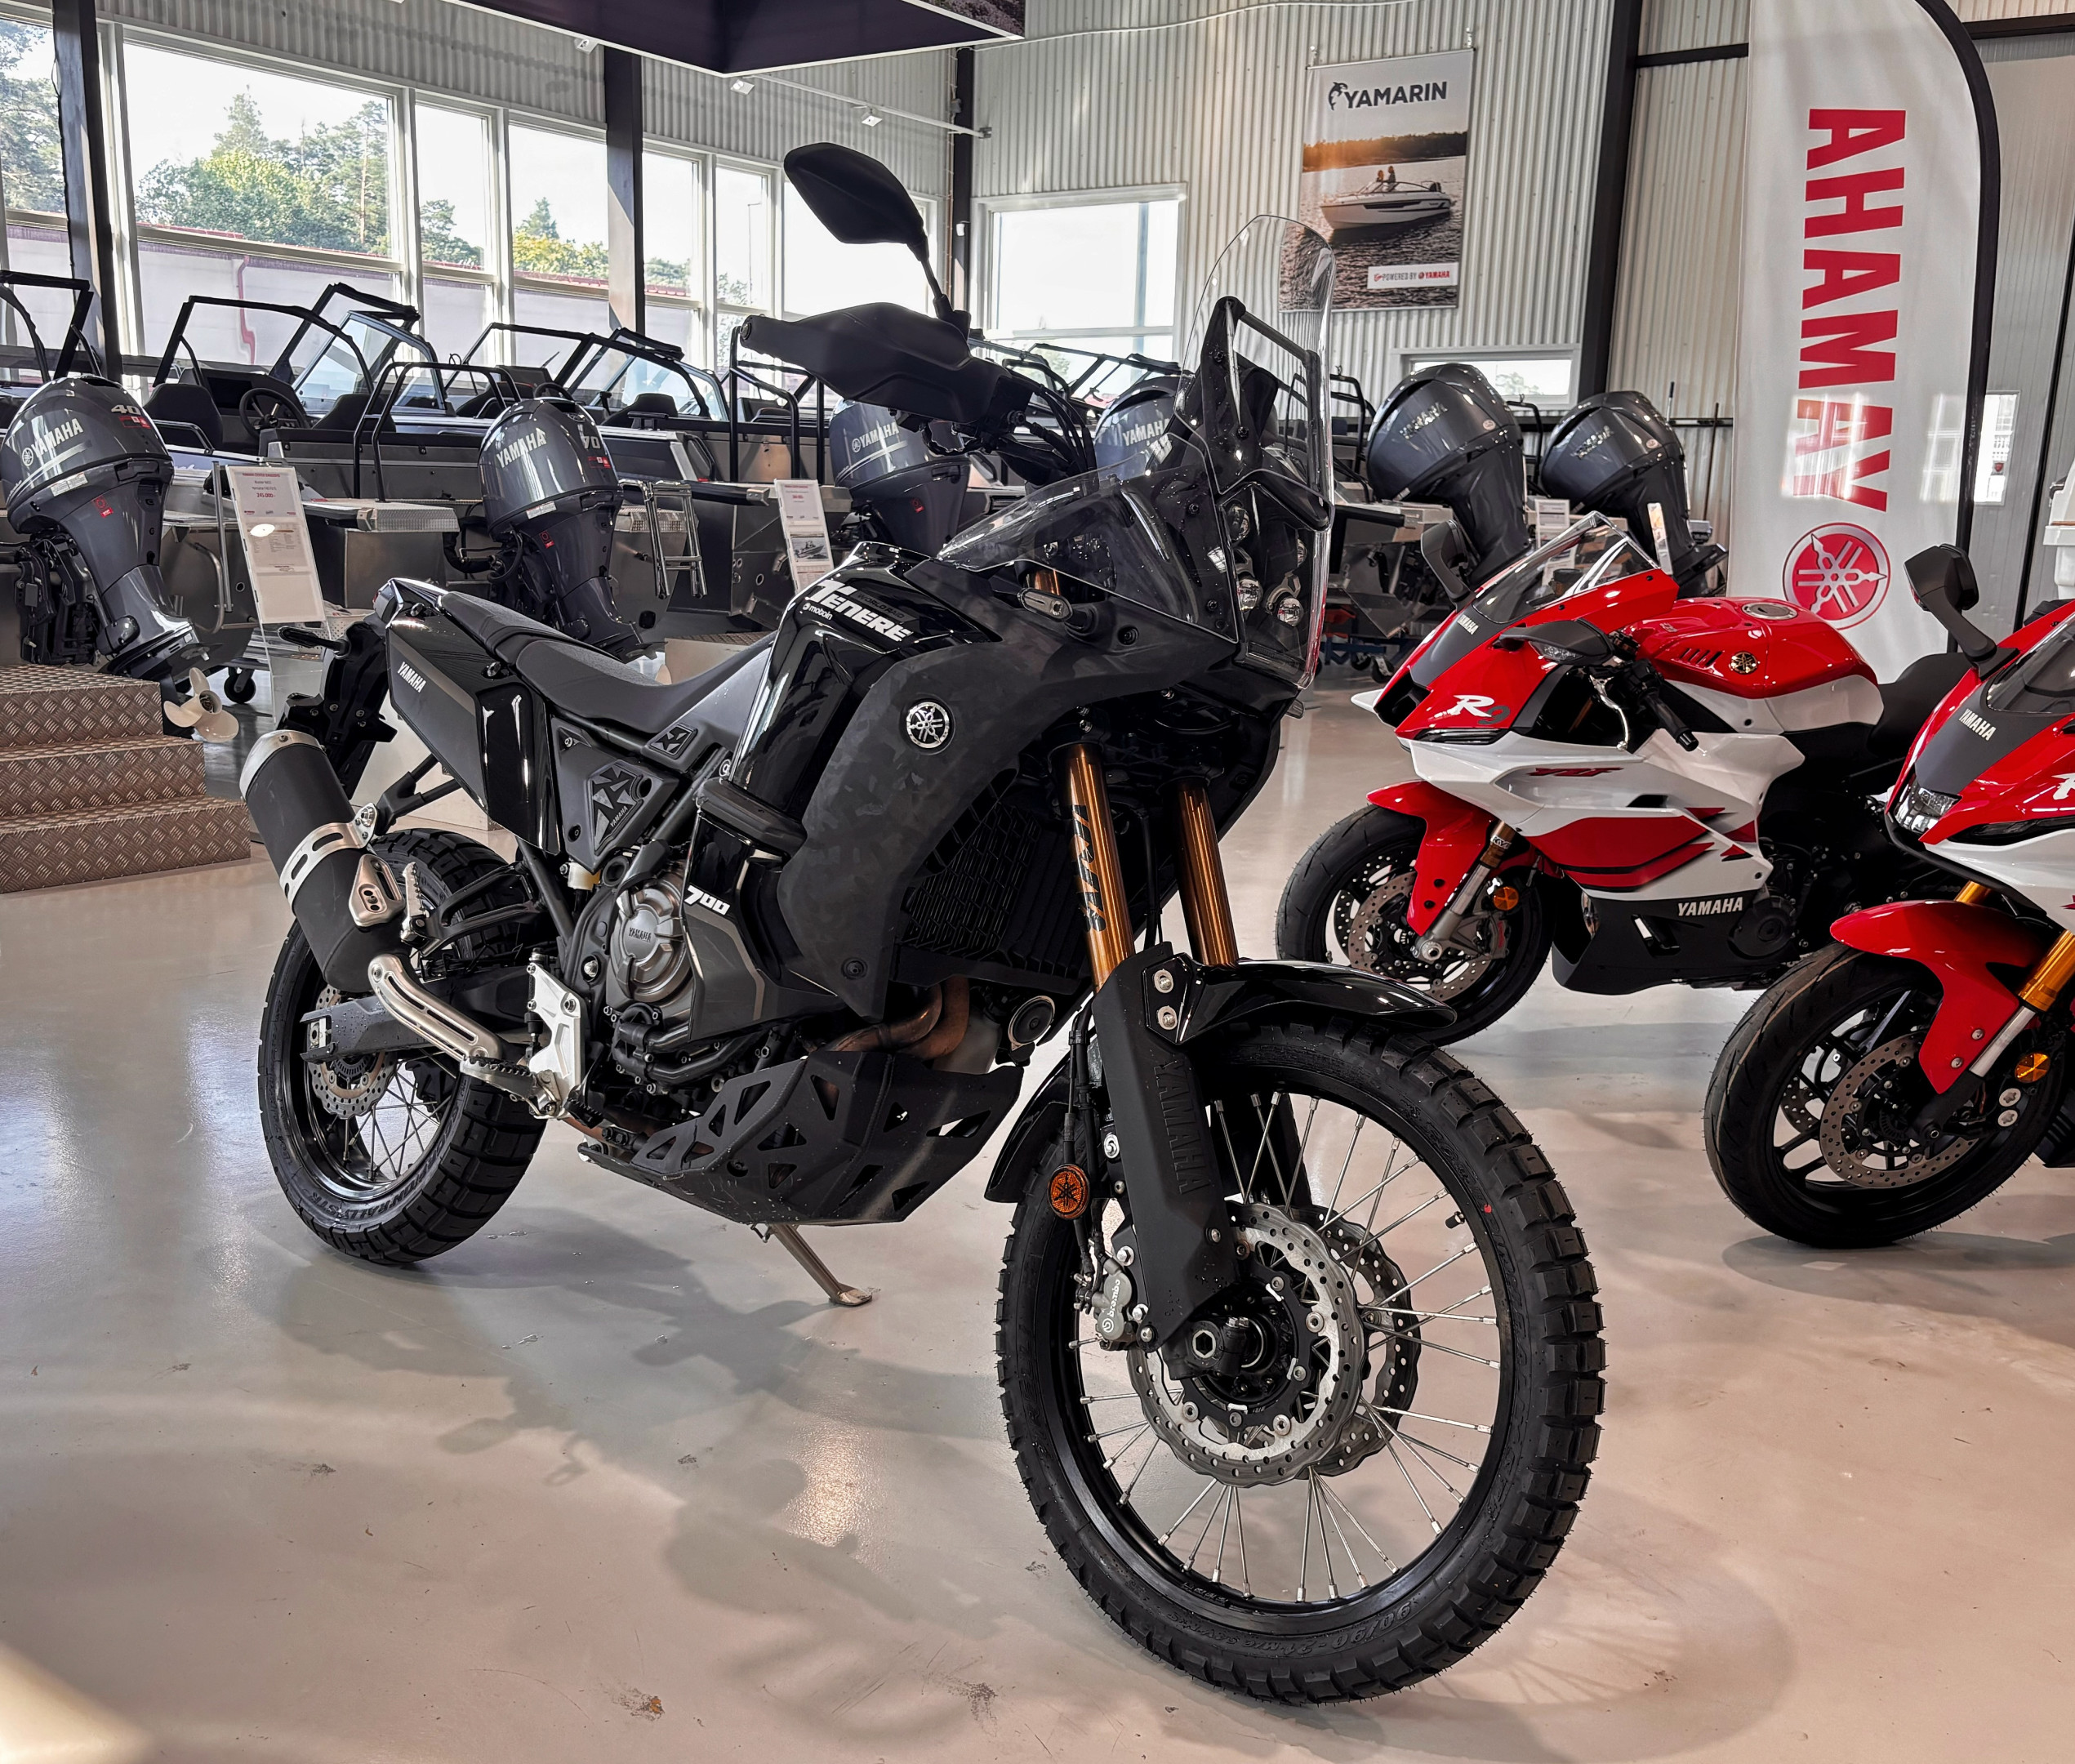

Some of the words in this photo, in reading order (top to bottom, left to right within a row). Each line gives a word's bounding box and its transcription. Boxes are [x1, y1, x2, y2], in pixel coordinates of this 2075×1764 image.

[1344, 82, 1447, 109] YAMARIN
[1382, 272, 1409, 281] POWERED
[1409, 272, 1417, 280] BY
[1425, 270, 1450, 279] YAMAHA
[1792, 108, 1906, 512] YAMAHA
[110, 404, 141, 416] 40
[31, 418, 84, 457] YAMAHA
[859, 421, 900, 448] YAMAHA
[496, 427, 548, 470] YAMAHA
[808, 604, 834, 621] motoin
[857, 593, 887, 611] WORLD
[884, 606, 906, 619] RAID
[1457, 613, 1480, 635] YAMAHA
[397, 661, 427, 693] YAMAHA
[1448, 694, 1511, 725] R9
[1959, 708, 1996, 742] YAMAHA
[609, 805, 629, 827] YAMAHA
[683, 885, 731, 915] 700
[1676, 896, 1743, 917] YAMAHA
[629, 927, 652, 942] YAMAHA
[1154, 1062, 1210, 1195] YAMAHA
[1107, 1278, 1121, 1318] brembo
